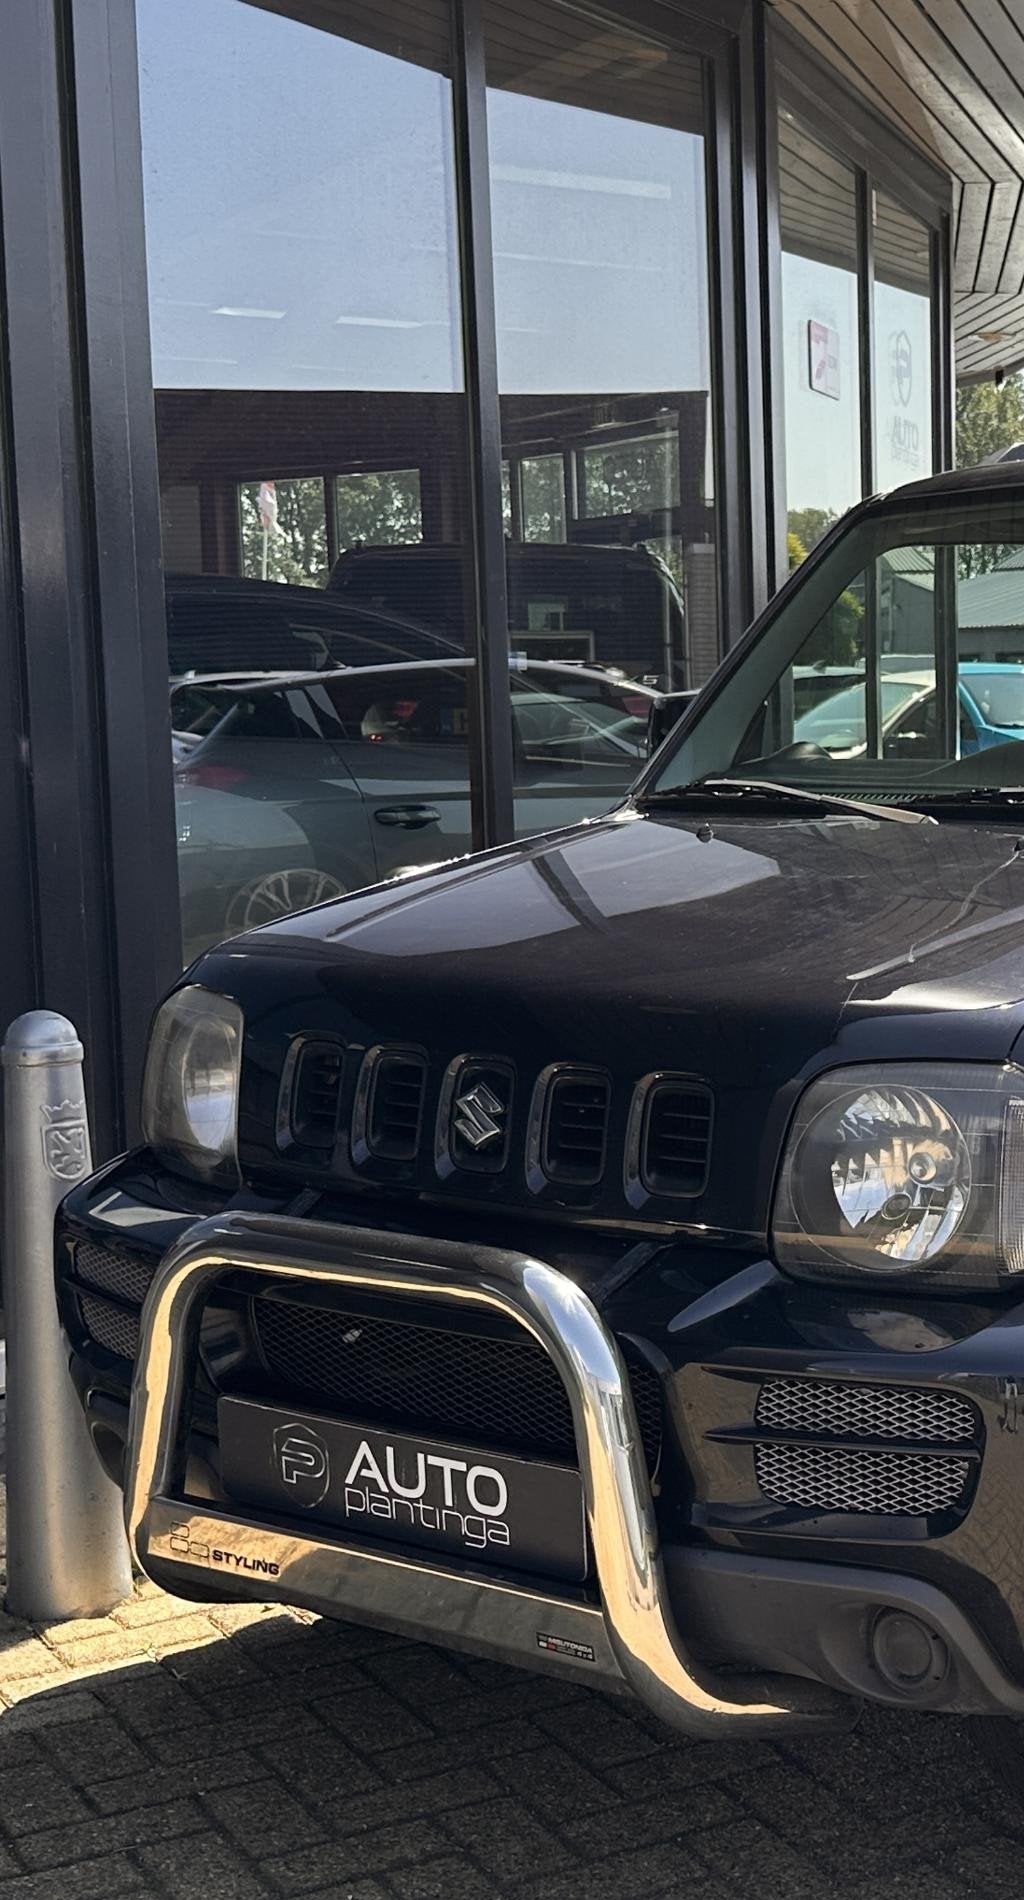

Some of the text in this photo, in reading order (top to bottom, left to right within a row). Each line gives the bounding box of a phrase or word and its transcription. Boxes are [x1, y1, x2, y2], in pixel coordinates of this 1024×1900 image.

[344, 1440, 508, 1527] AUTO
[344, 1486, 511, 1549] plantinga
[212, 1549, 280, 1576] STYLING
